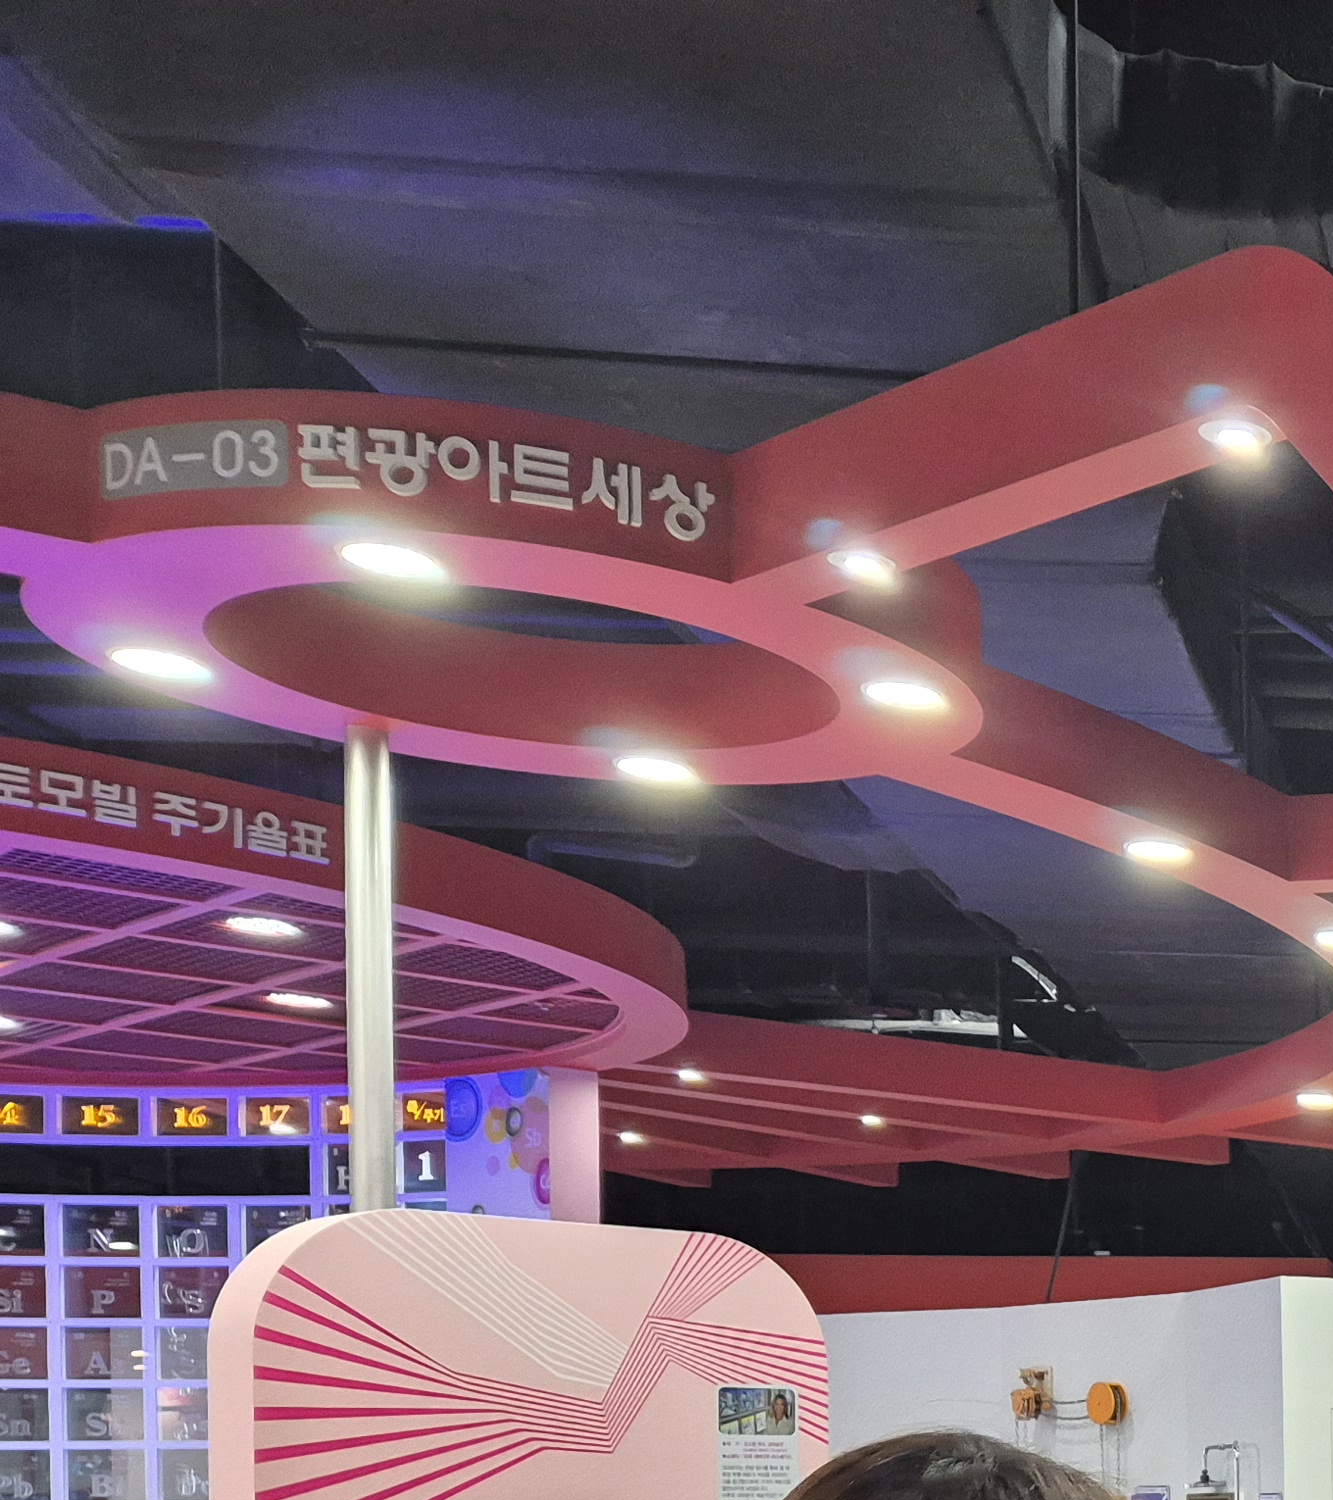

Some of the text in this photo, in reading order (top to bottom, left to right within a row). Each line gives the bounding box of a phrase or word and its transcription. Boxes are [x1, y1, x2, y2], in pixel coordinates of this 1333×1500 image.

[104, 424, 715, 542] DA-03 편광아트세상
[152, 791, 330, 866] 주기율표
[81, 1104, 117, 1128] 15
[174, 1105, 208, 1129] 16
[259, 1104, 291, 1128] 17
[339, 1104, 351, 1126] 1
[418, 1151, 434, 1181] 1
[91, 1290, 115, 1315] P
